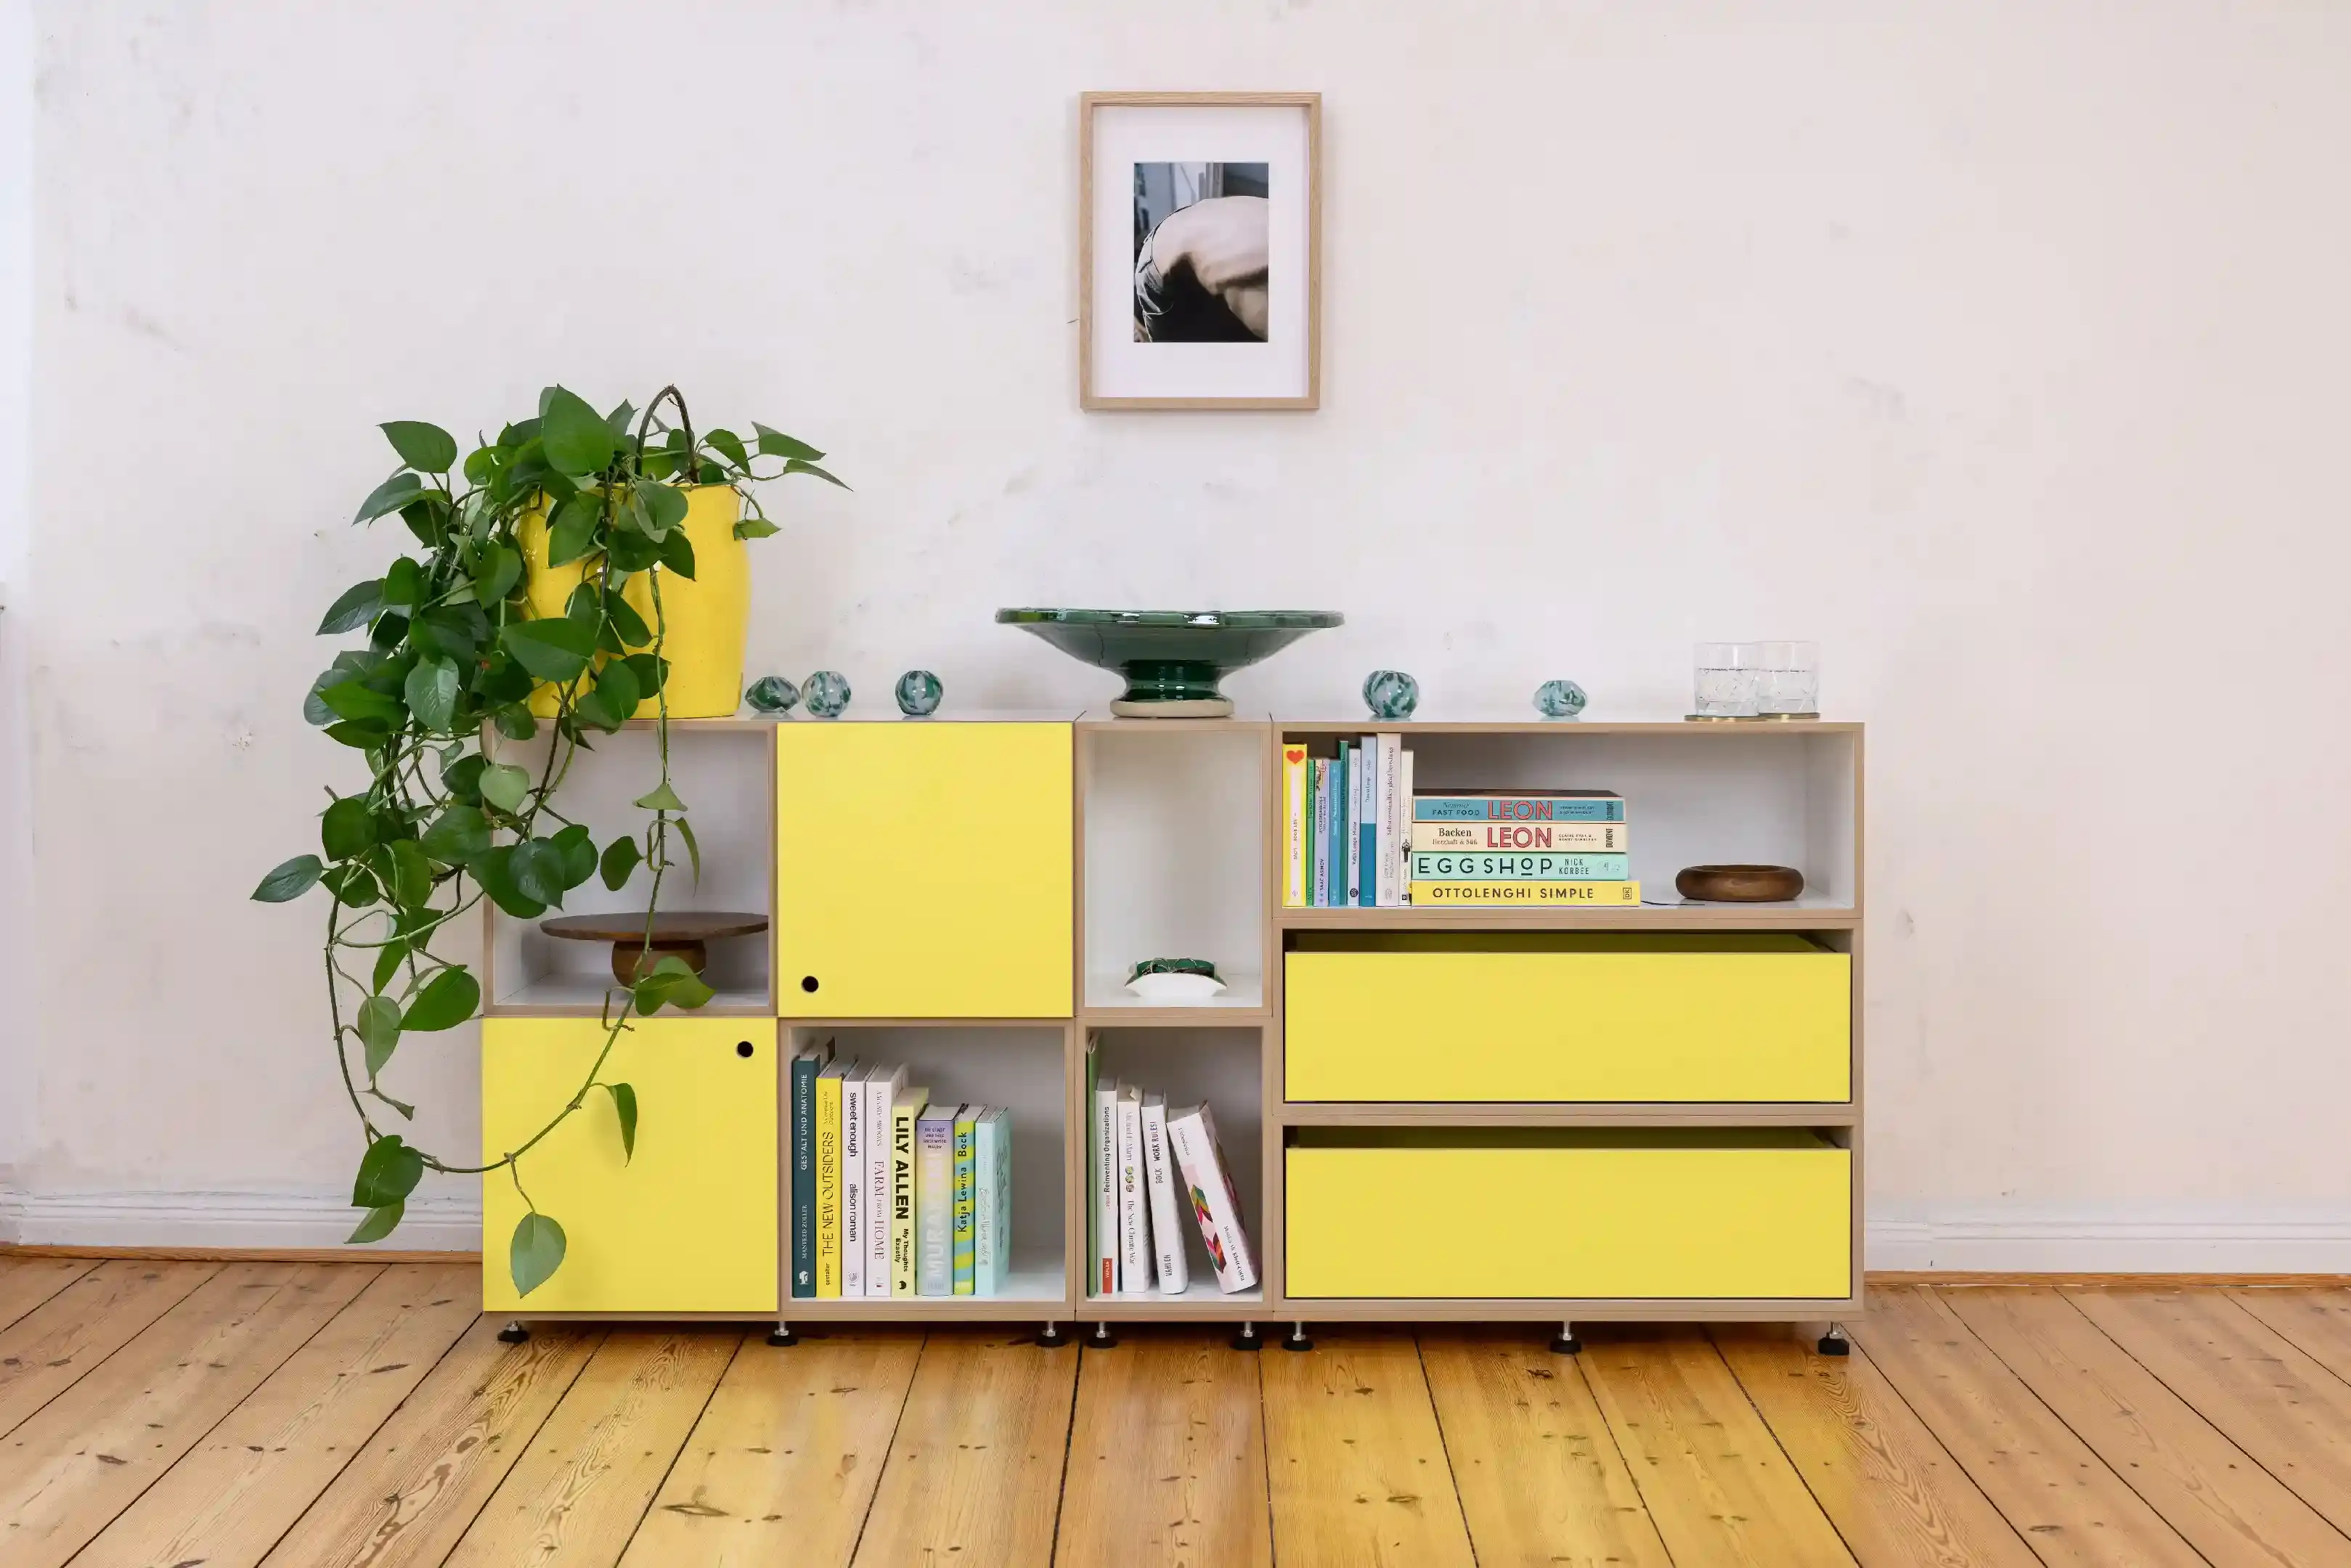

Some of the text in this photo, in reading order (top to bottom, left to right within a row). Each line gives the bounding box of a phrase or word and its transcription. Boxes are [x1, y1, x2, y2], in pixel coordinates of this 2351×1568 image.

[1488, 801, 1553, 820] LEON
[1438, 828, 1472, 837] Backen
[1487, 827, 1552, 848] LEON
[1433, 887, 1594, 899] OTTOLENGHI SIMPLE
[1623, 889, 1631, 899] DK
[847, 1122, 858, 1157] enough
[958, 1132, 967, 1157] Bock
[1149, 1121, 1161, 1161] WORK RULES!
[874, 1160, 884, 1197] FARM
[895, 1116, 909, 1220] LILY ALLEN
[1154, 1168, 1163, 1184] BOCK
[822, 1131, 834, 1257] THE NEW OUTSIDERS
[958, 1167, 970, 1233] Katja Lewina
[926, 1153, 944, 1280] MURAI
[874, 1220, 884, 1259] HOME
[901, 1228, 909, 1239] My
[1163, 1254, 1173, 1277] VAHLEN
[1232, 1252, 1245, 1281] Klett-Cotta
